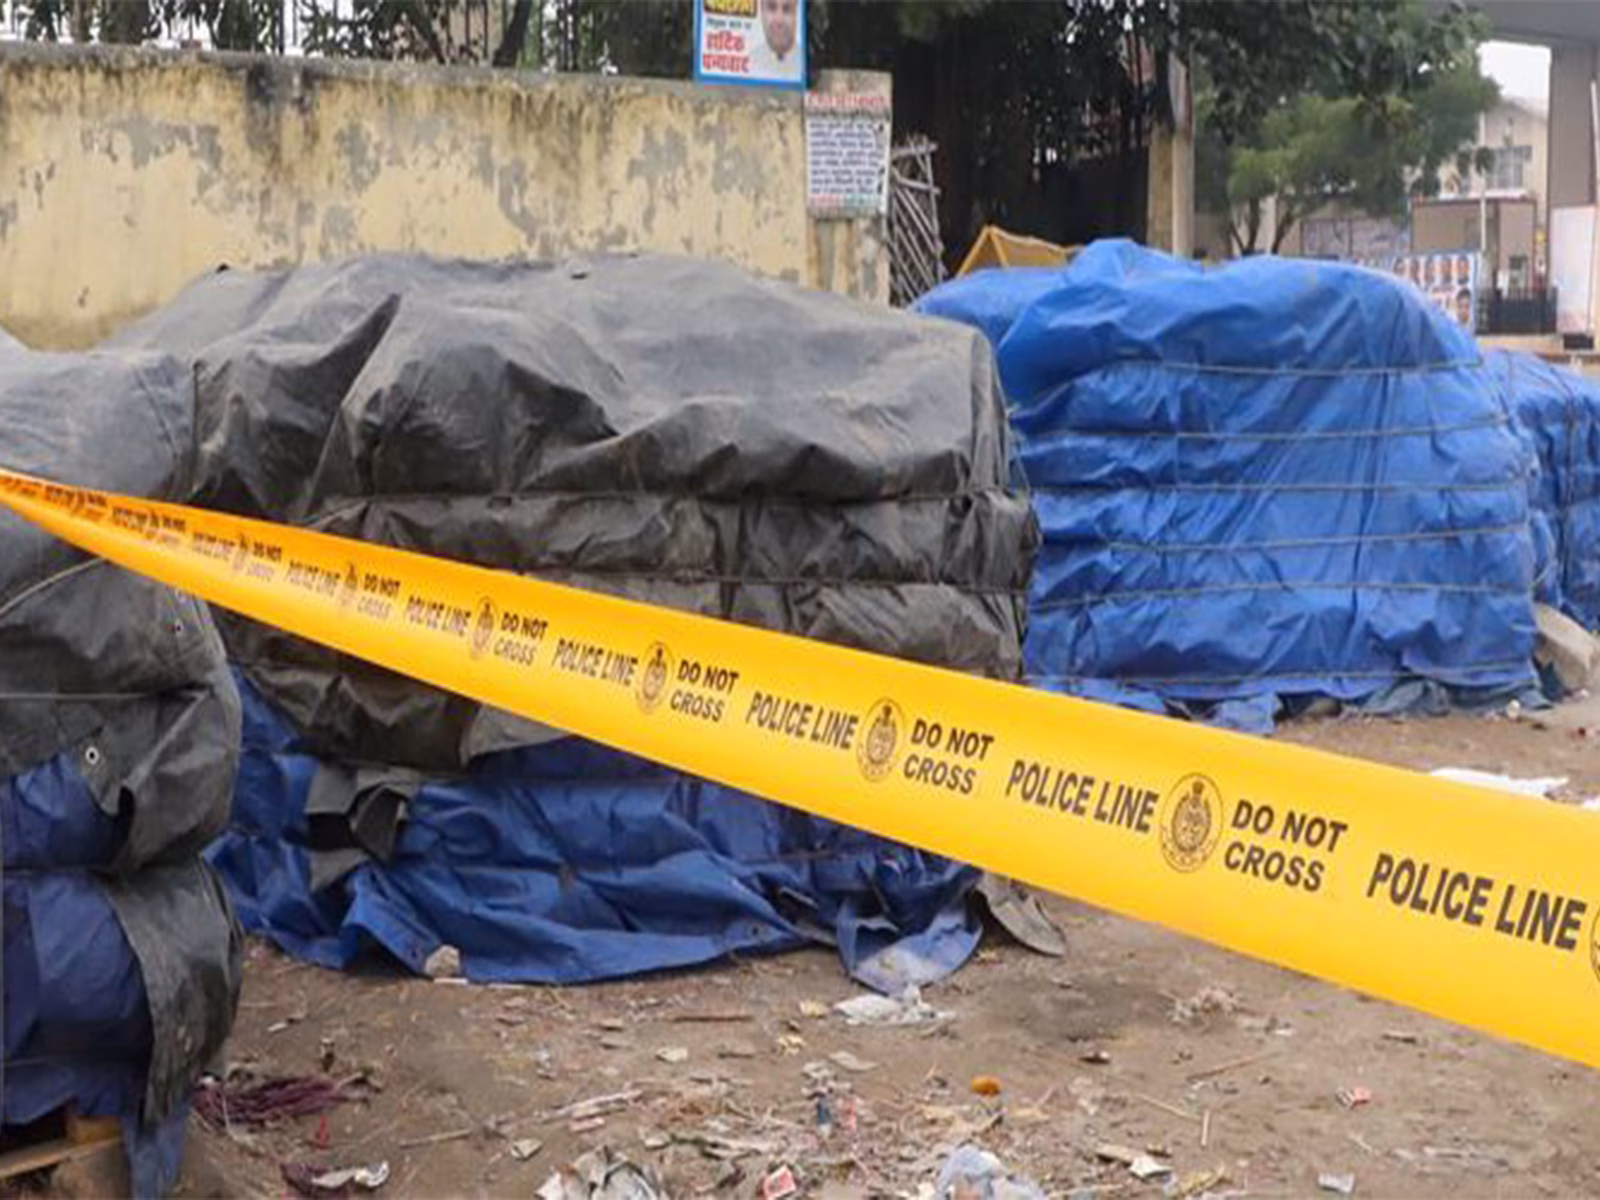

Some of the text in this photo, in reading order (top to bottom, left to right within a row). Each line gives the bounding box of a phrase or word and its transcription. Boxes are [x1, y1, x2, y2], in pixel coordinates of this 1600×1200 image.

[363, 573, 400, 600] DO NOT
[403, 596, 471, 637] POLICE LINE
[501, 612, 548, 641] DO NOT
[494, 637, 537, 666] CROSS
[551, 638, 638, 687] POLICE LINE
[677, 659, 740, 693] DO NOT
[670, 689, 726, 723] CROSS
[746, 691, 859, 750] POLICE LINE
[911, 719, 995, 761] DO NOT
[903, 754, 977, 795] CROSS
[1006, 760, 1160, 834] POLICE LINE
[1231, 800, 1348, 852] DO NOT
[1224, 842, 1326, 892] CROSS
[1366, 852, 1588, 950] POLICE LINE
